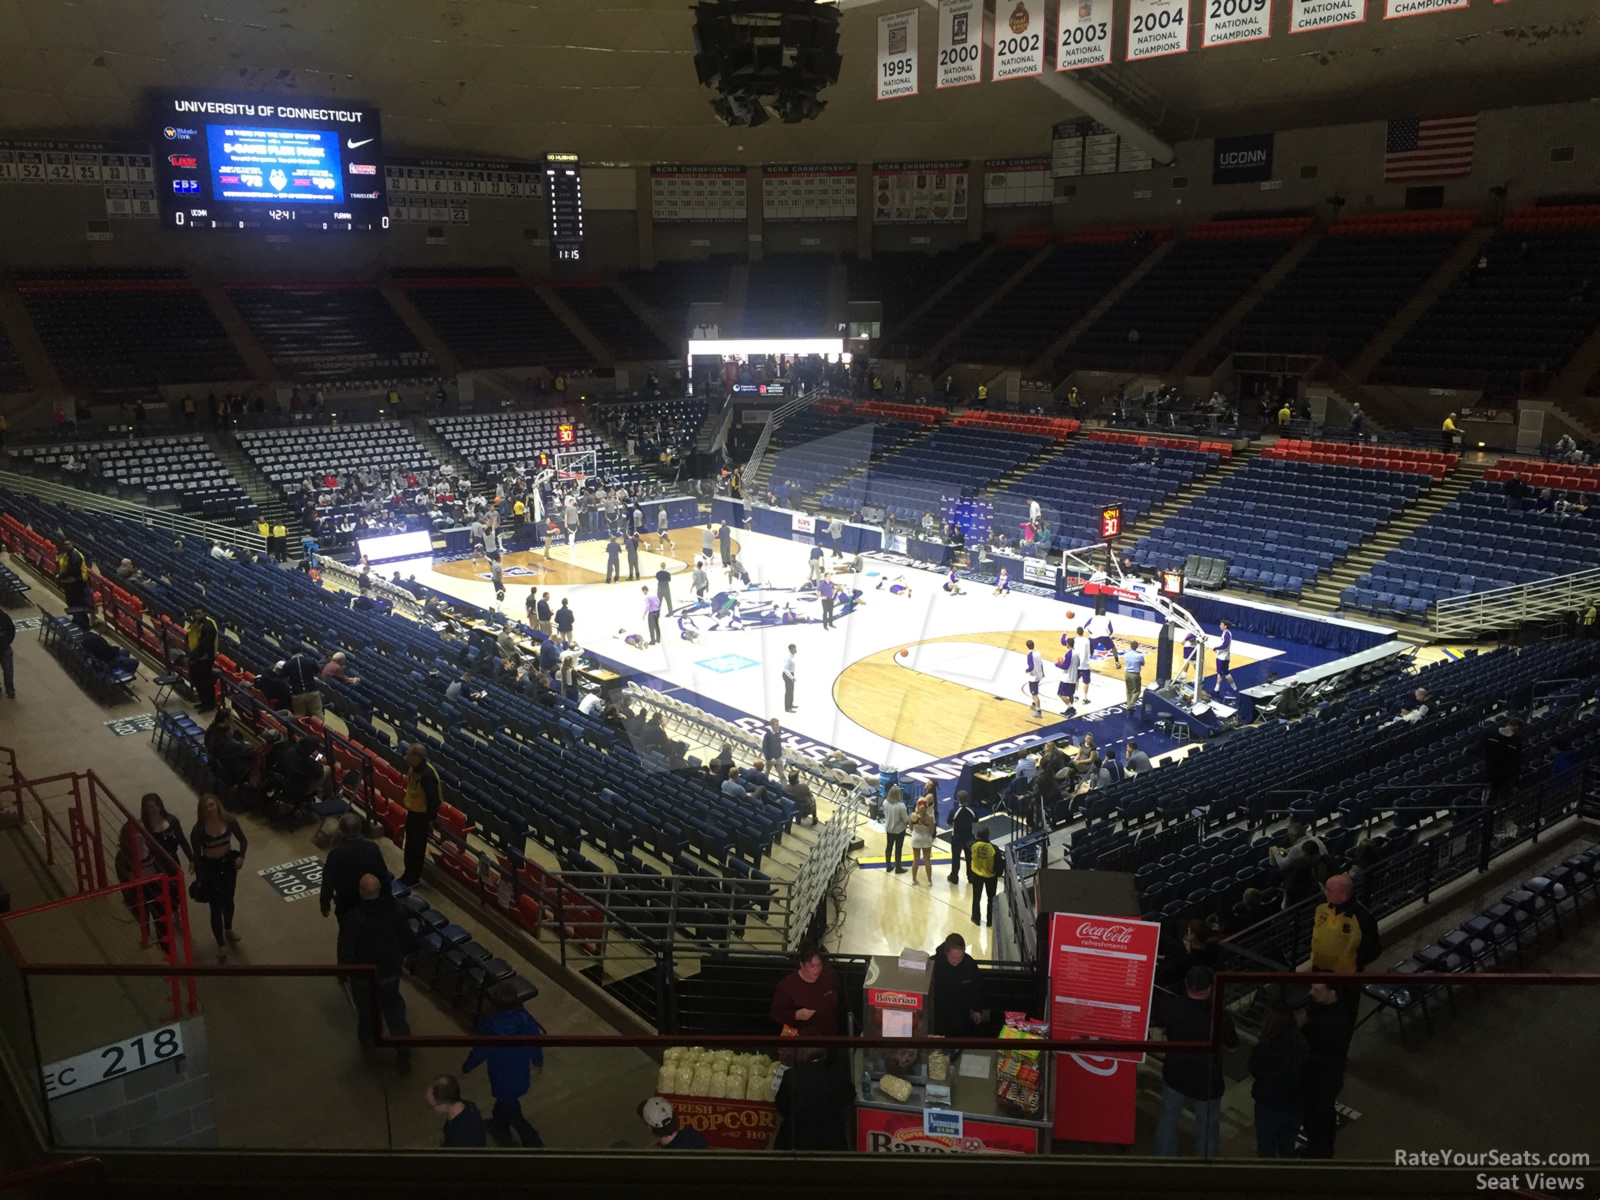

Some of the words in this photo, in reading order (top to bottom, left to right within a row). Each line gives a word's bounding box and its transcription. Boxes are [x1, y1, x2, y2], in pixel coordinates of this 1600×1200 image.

[1210, 0, 1266, 19] 2009
[1303, 0, 1353, 15] NATIONAL
[1132, 8, 1184, 34] 2004
[1214, 16, 1259, 31] NATIONAL
[1298, 11, 1357, 29] CHAMPIONS
[1062, 22, 1107, 46] 2003
[1137, 31, 1178, 45] NATIONAL
[1210, 27, 1263, 43] CHAMPIONS
[998, 34, 1039, 56] 2002
[1065, 45, 1102, 57] NATIONAL
[1133, 42, 1181, 56] CHAMPIONS
[940, 45, 978, 66] 2000
[1001, 55, 1035, 66] NATIONAL
[1062, 55, 1105, 68] CHAMPIONS
[882, 58, 912, 77] 1995
[944, 64, 973, 76] NATIONAL
[998, 65, 1038, 77] CHAMPIONS
[883, 77, 911, 87] NATIONAL
[941, 74, 976, 86] CHAMPIONS
[881, 86, 914, 97] CHAMPIONS
[175, 100, 255, 116] UNIVERSITY
[258, 105, 274, 117] OF
[277, 106, 363, 122] CONNECTICUT
[1219, 149, 1267, 166] UCONN
[23, 165, 41, 178] 52
[51, 166, 70, 178] 42
[176, 211, 185, 225] 0
[453, 209, 466, 220] 23
[382, 216, 390, 229] 0
[560, 431, 572, 441] 30
[1102, 518, 1118, 537] 30
[274, 875, 307, 895] 119
[1075, 921, 1136, 944] Coca-Cola
[1081, 939, 1128, 951] refreshments
[875, 993, 917, 1005] Bavarian
[45, 1067, 78, 1092] EC
[101, 1028, 179, 1079] 218
[671, 1103, 713, 1114] FRESH
[678, 1110, 776, 1132] POPCOR
